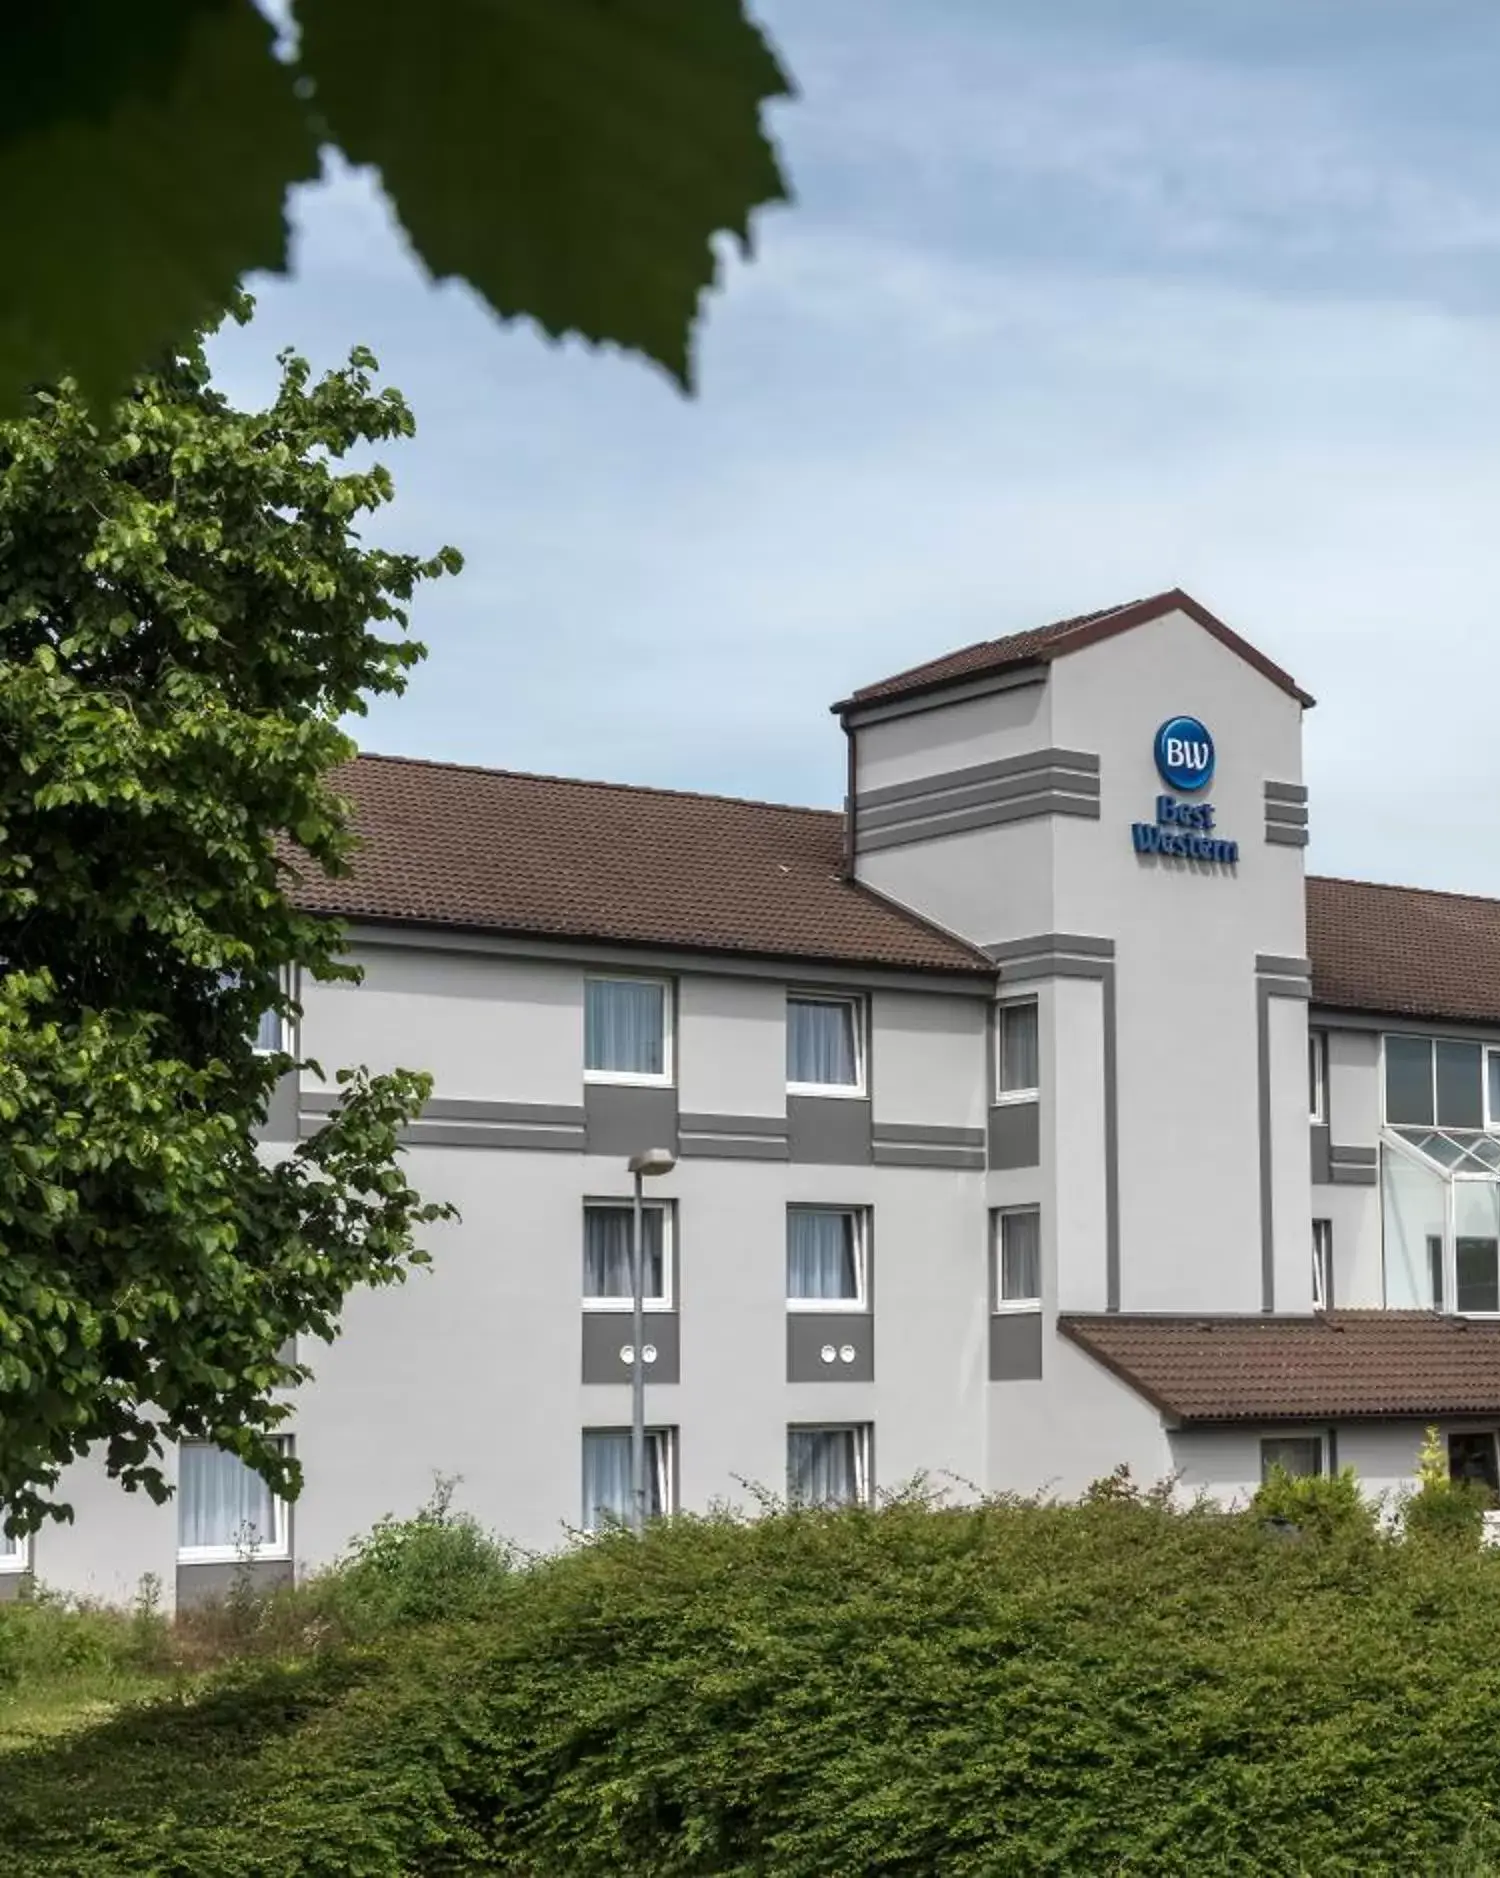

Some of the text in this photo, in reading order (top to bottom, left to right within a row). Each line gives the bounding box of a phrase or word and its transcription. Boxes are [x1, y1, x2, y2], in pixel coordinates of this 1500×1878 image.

[1167, 738, 1209, 770] BW
[1156, 795, 1216, 830] Best
[1131, 823, 1240, 864] Western
